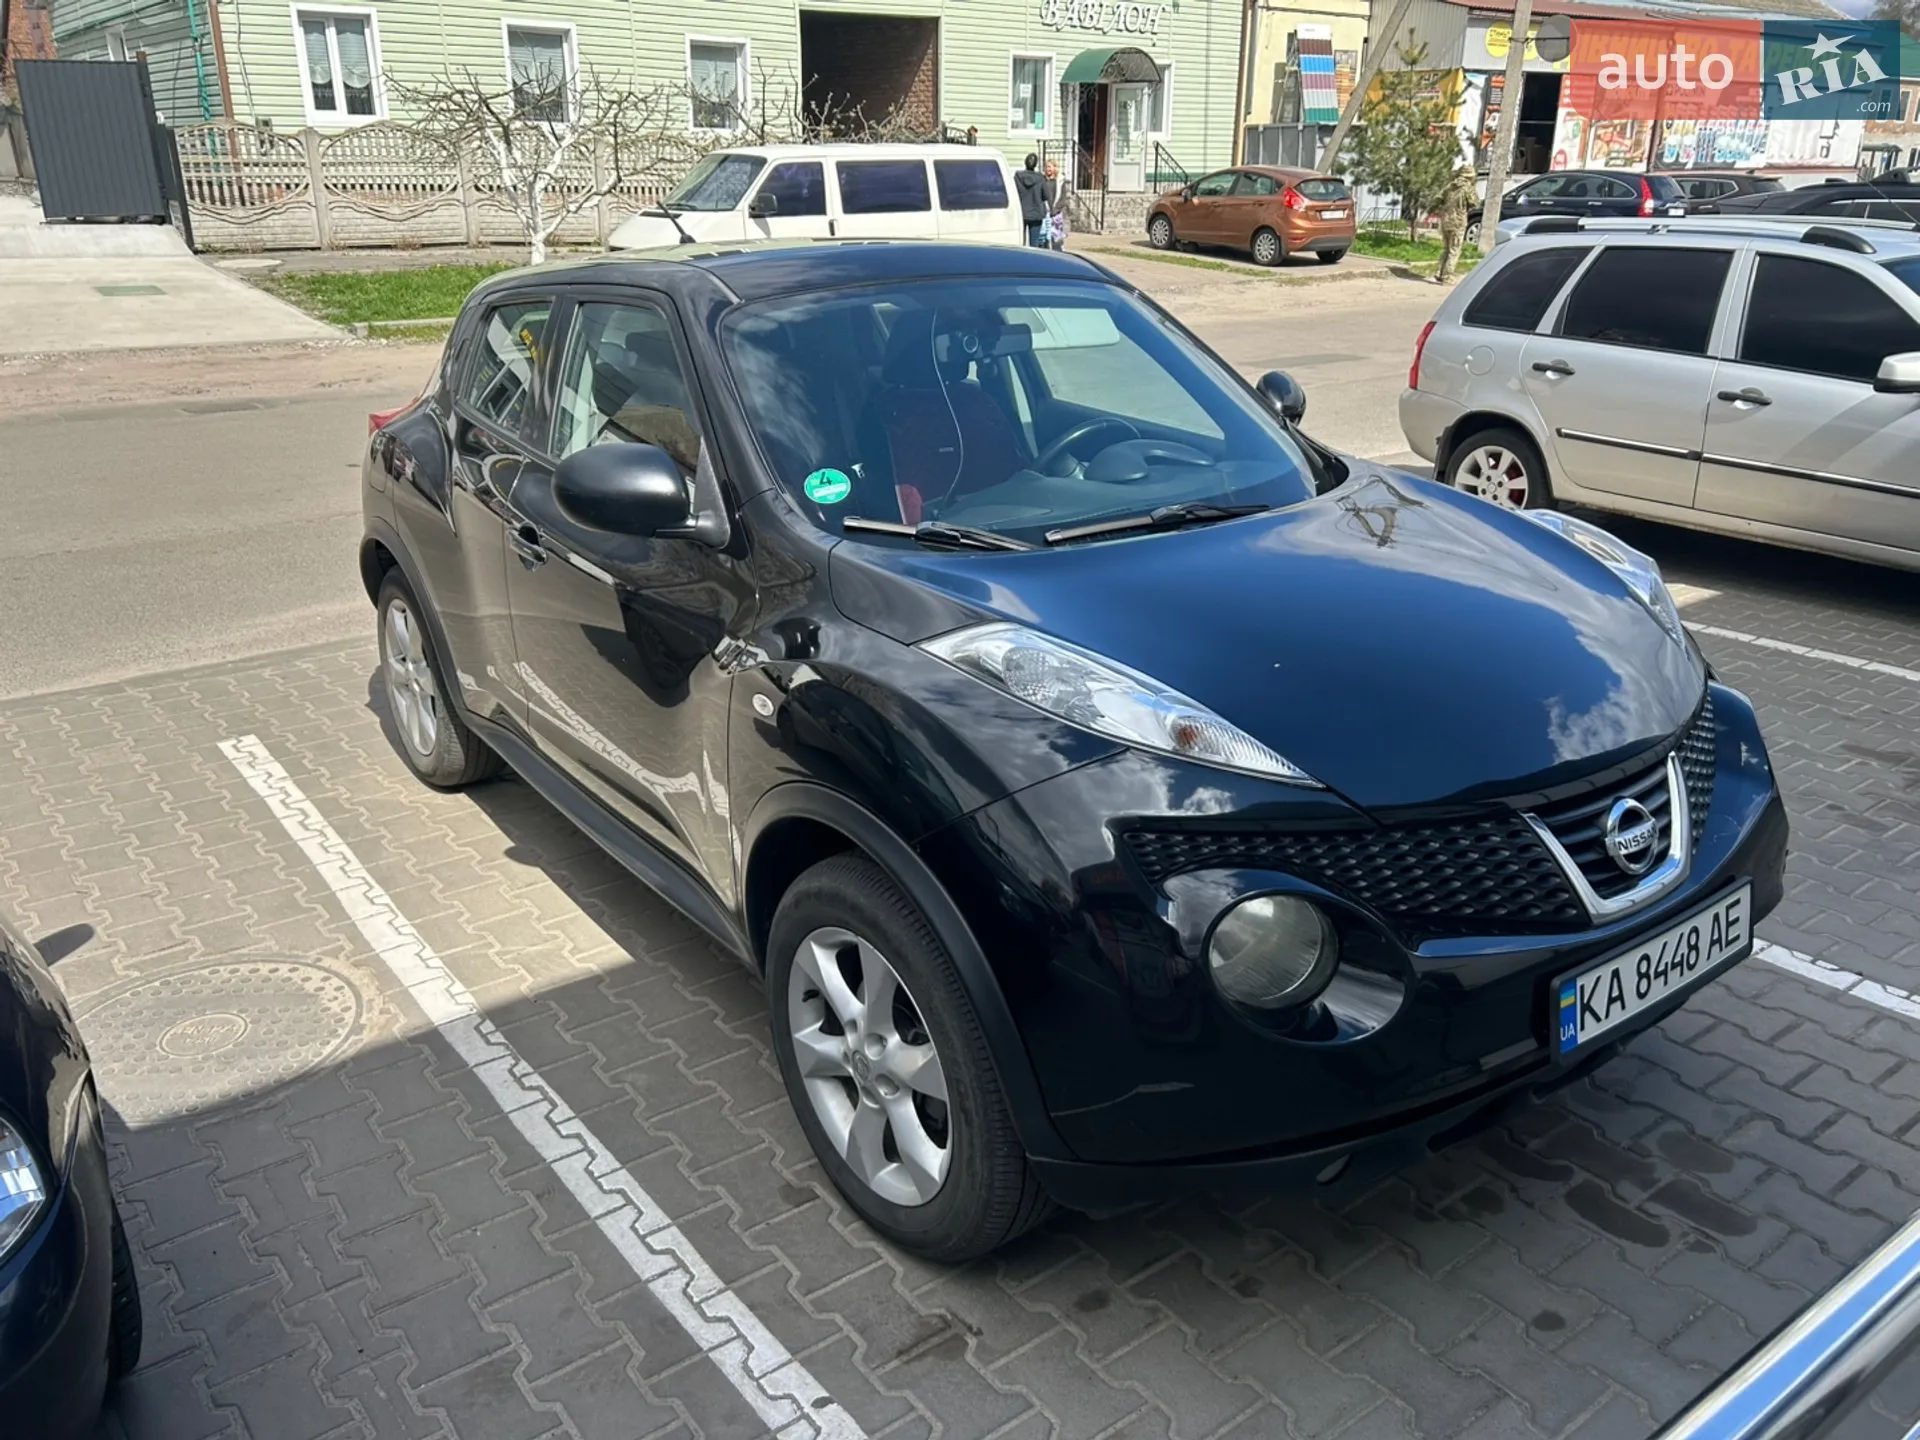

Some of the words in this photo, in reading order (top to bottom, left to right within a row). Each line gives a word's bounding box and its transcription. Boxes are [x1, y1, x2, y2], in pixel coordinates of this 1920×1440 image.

[1040, 0, 1168, 35] ВАВІЛОН
[819, 471, 832, 485] 4
[1579, 967, 1626, 1032] KA
[1635, 925, 1700, 1001] 8448
[1706, 897, 1742, 962] AE
[1560, 1021, 1576, 1042] UA
